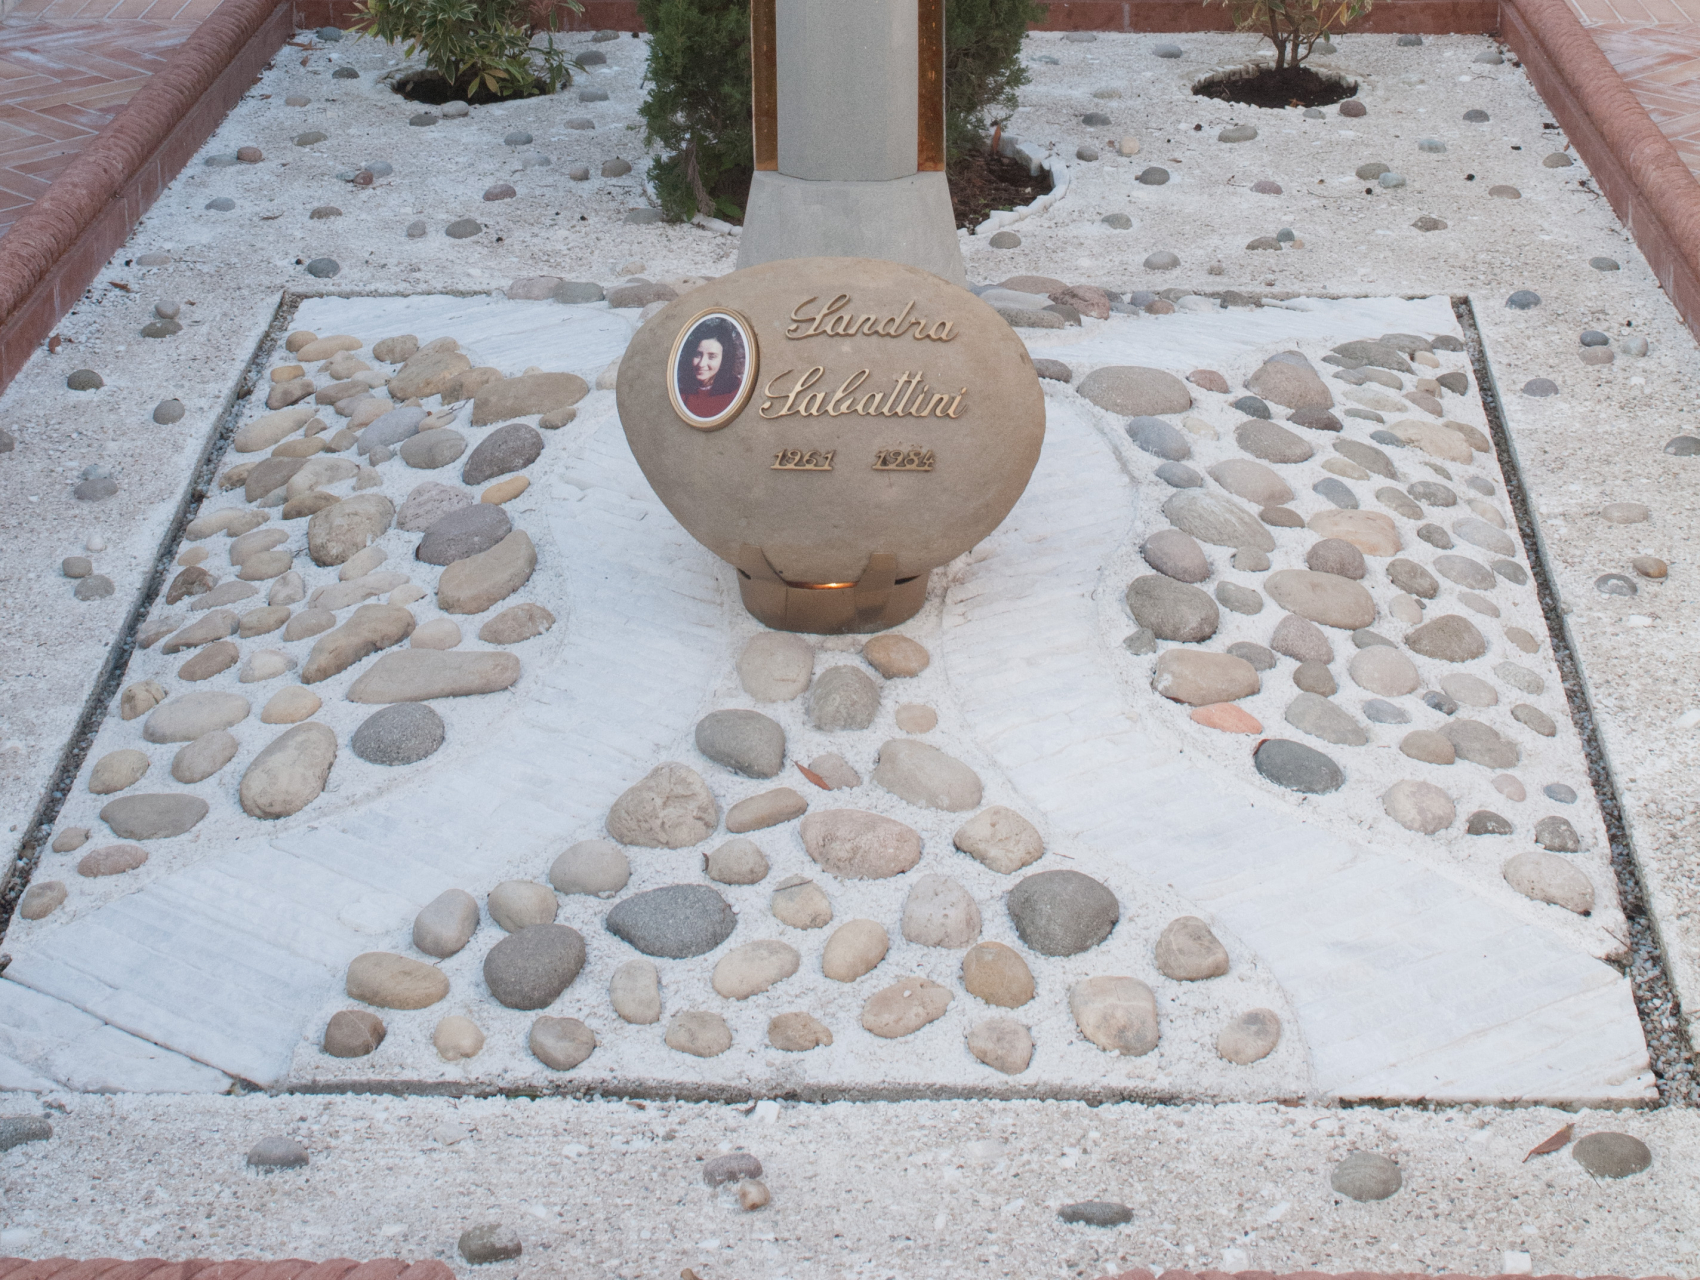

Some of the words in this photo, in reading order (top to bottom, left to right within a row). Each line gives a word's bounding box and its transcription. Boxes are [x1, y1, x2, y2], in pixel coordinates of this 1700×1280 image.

[785, 292, 960, 343] Sandra
[758, 364, 968, 420] Sabattini
[770, 447, 838, 472] 1961
[872, 447, 936, 472] 1984
